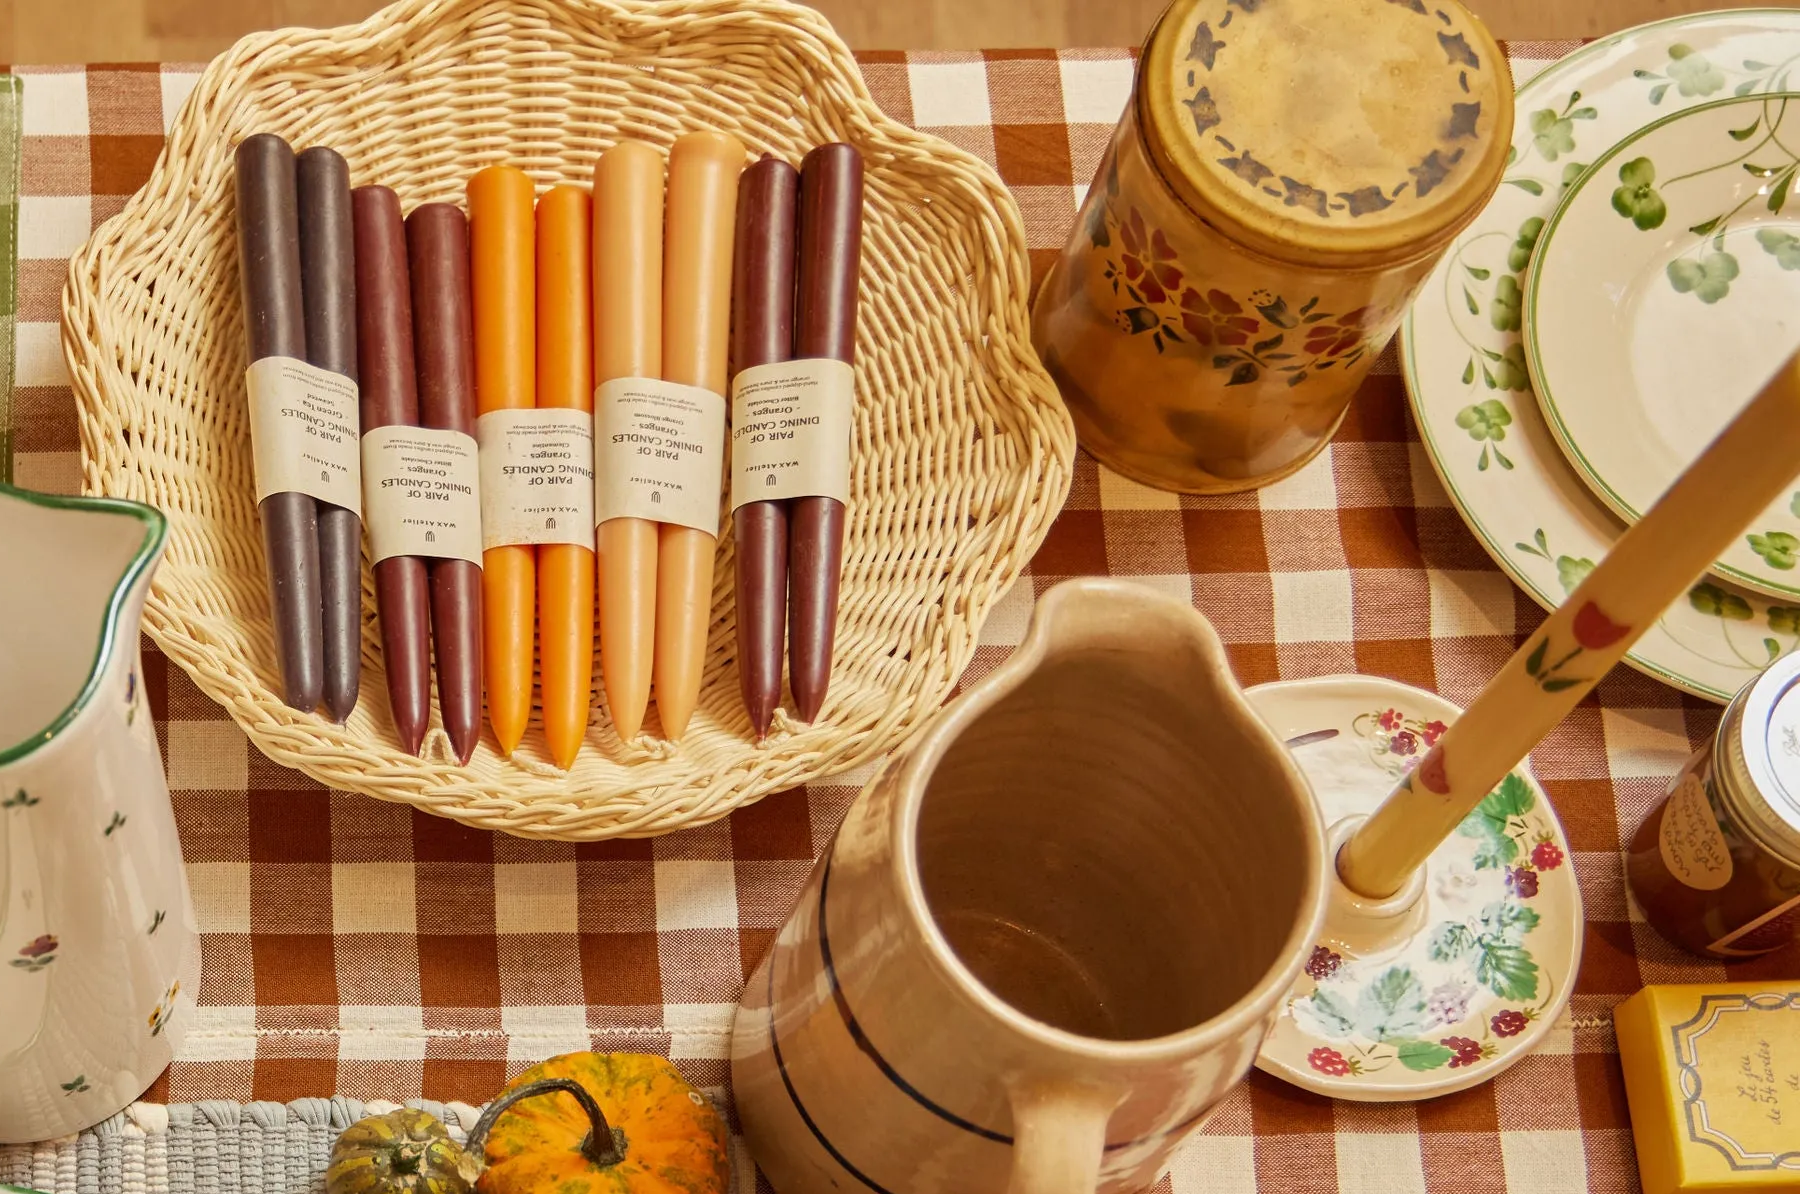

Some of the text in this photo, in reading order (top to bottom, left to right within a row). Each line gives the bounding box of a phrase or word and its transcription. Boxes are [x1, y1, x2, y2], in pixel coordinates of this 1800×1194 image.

[302, 400, 344, 419] Green Tea
[752, 406, 793, 417] Oranges
[281, 408, 326, 428] CANDLES
[779, 416, 820, 428] DINING
[305, 425, 342, 444] PAIR OF
[639, 422, 678, 436] Oranges
[612, 433, 703, 454] DINING CANDLES
[750, 430, 794, 444] PAIR OF
[530, 450, 572, 459] Oranges
[636, 446, 679, 461] PAIR OF
[301, 452, 348, 473] WAX Atelier
[745, 459, 799, 473] WAX Atelier
[407, 465, 447, 477] Oranges
[502, 464, 595, 480] DINING CANDLES
[381, 478, 472, 495] DINING CANDLES
[528, 476, 573, 486] PAIR OF
[629, 476, 683, 491] WAX Atelier
[407, 489, 450, 501] PAIR OF
[523, 505, 556, 513] Atelier
[402, 518, 435, 527] Atelier
[1759, 1085, 1778, 1104] 54
[1766, 1108, 1782, 1126] de
